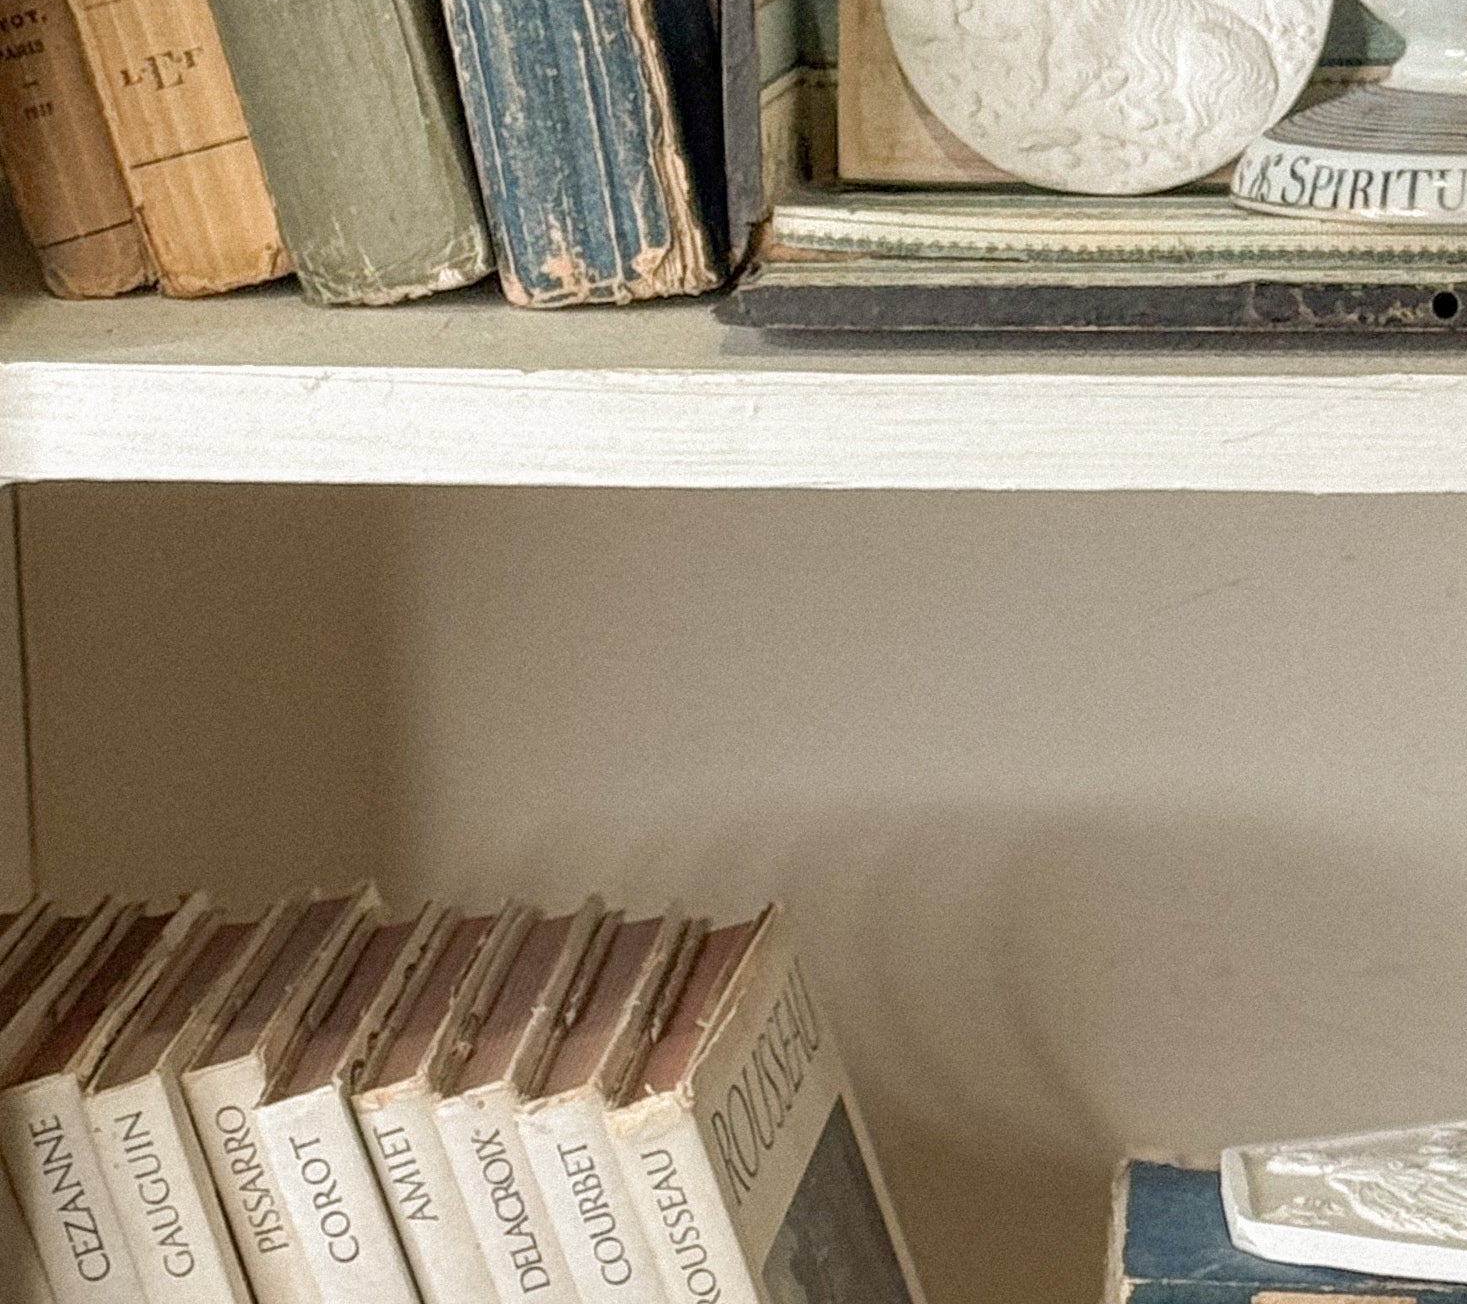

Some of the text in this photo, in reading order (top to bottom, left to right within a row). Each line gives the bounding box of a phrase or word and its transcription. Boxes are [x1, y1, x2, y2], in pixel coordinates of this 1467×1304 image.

[710, 957, 820, 1206] ROUSSEAU
[28, 1114, 112, 1283] CEZANNE
[114, 1109, 195, 1279] GAUGUIN
[214, 1104, 290, 1254] PISSARRO
[288, 1136, 361, 1264] COROT
[373, 1125, 440, 1224] AMIET
[471, 1127, 551, 1294] DELACROIX
[556, 1142, 633, 1287] COURBET
